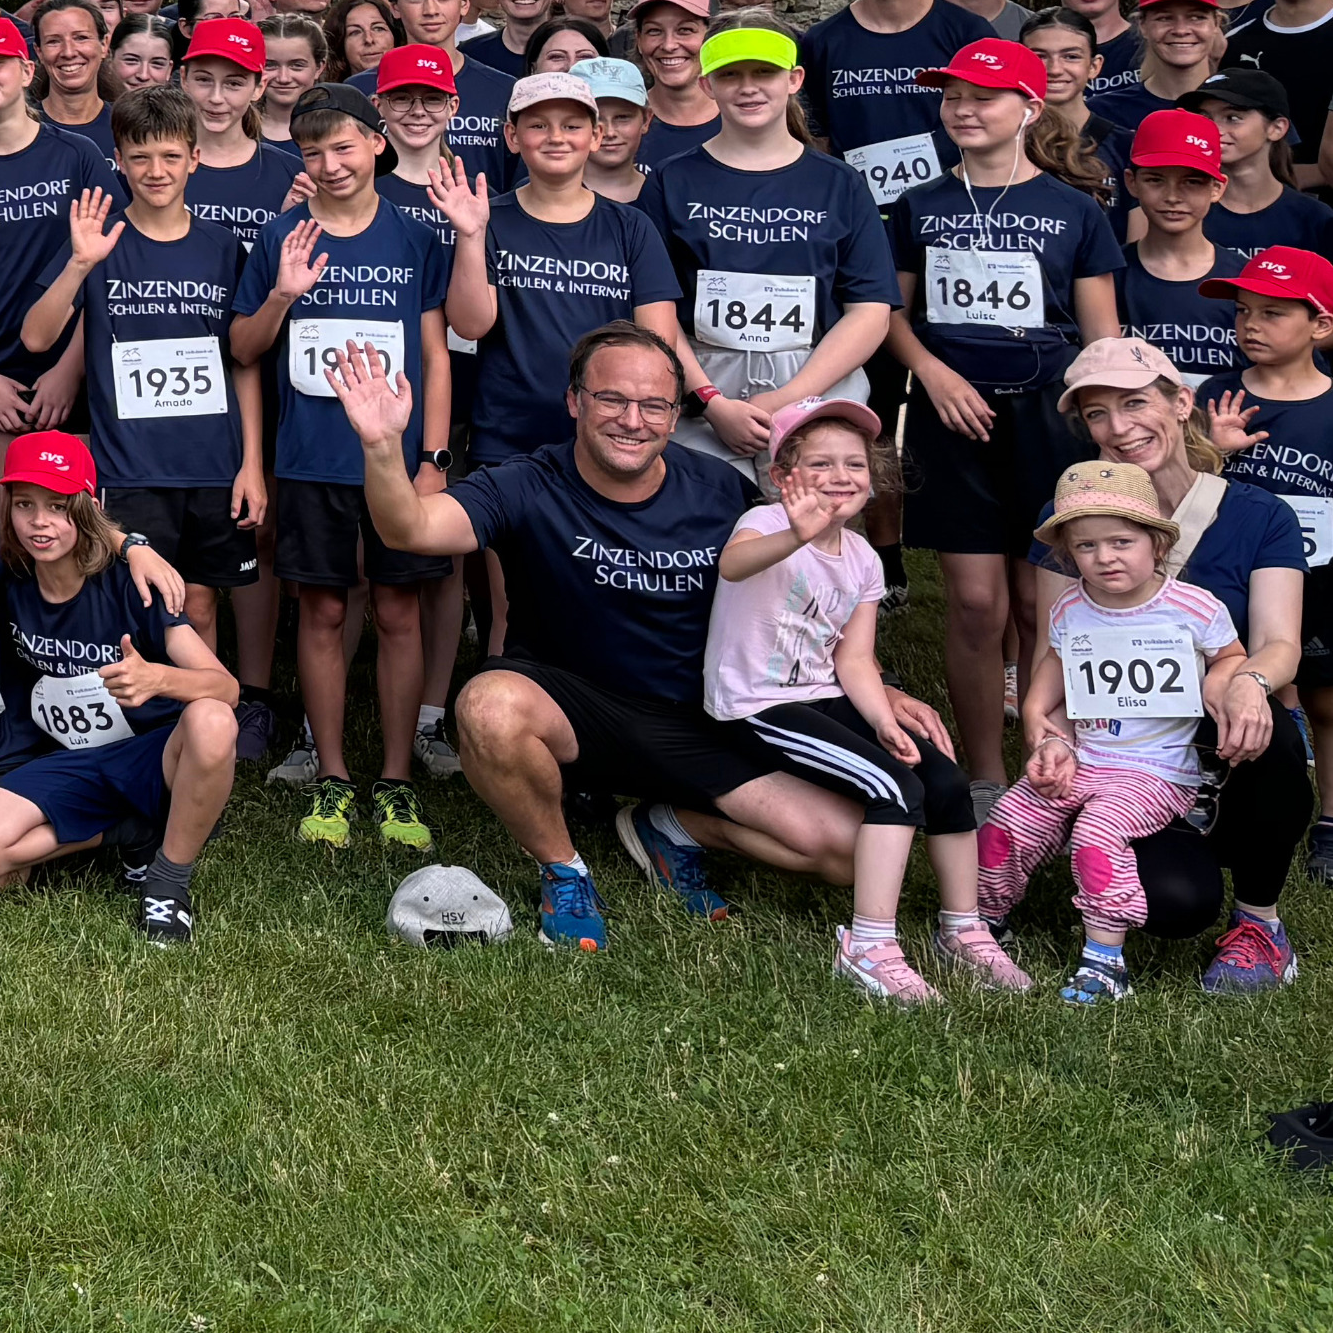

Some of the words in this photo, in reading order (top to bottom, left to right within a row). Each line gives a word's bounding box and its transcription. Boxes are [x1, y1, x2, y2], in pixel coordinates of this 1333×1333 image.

[228, 34, 249, 46] SVS
[417, 59, 438, 69] SVS
[971, 52, 998, 64] SVS
[832, 85, 880, 99] SCHULEN
[884, 85, 892, 95] &
[1186, 135, 1208, 148] SVS
[687, 202, 827, 224] ZINZENDORF
[709, 220, 808, 244] SCHULEN
[920, 213, 1067, 235] ZINZENDORF
[938, 232, 1044, 253] SCHULEN
[1258, 260, 1286, 274] SVS
[107, 279, 227, 303] ZINZENDORF
[301, 288, 397, 307] SCHULEN
[556, 280, 565, 292] &
[569, 280, 630, 301] INTERNAT
[936, 277, 1031, 309] 1846
[108, 302, 164, 316] SCHULEN
[168, 303, 177, 314] &
[707, 299, 805, 333] 1844
[739, 333, 770, 343] Anna
[129, 365, 212, 398] 1935
[40, 451, 64, 464] SVS
[1257, 466, 1268, 478] &
[572, 535, 718, 569] ZINZENDORF
[594, 565, 704, 592] SCHULEN
[57, 662, 66, 674] &
[1079, 658, 1184, 695] 1902
[1117, 696, 1147, 708] Elisa
[38, 702, 113, 734] 1883
[69, 736, 89, 745] Luis
